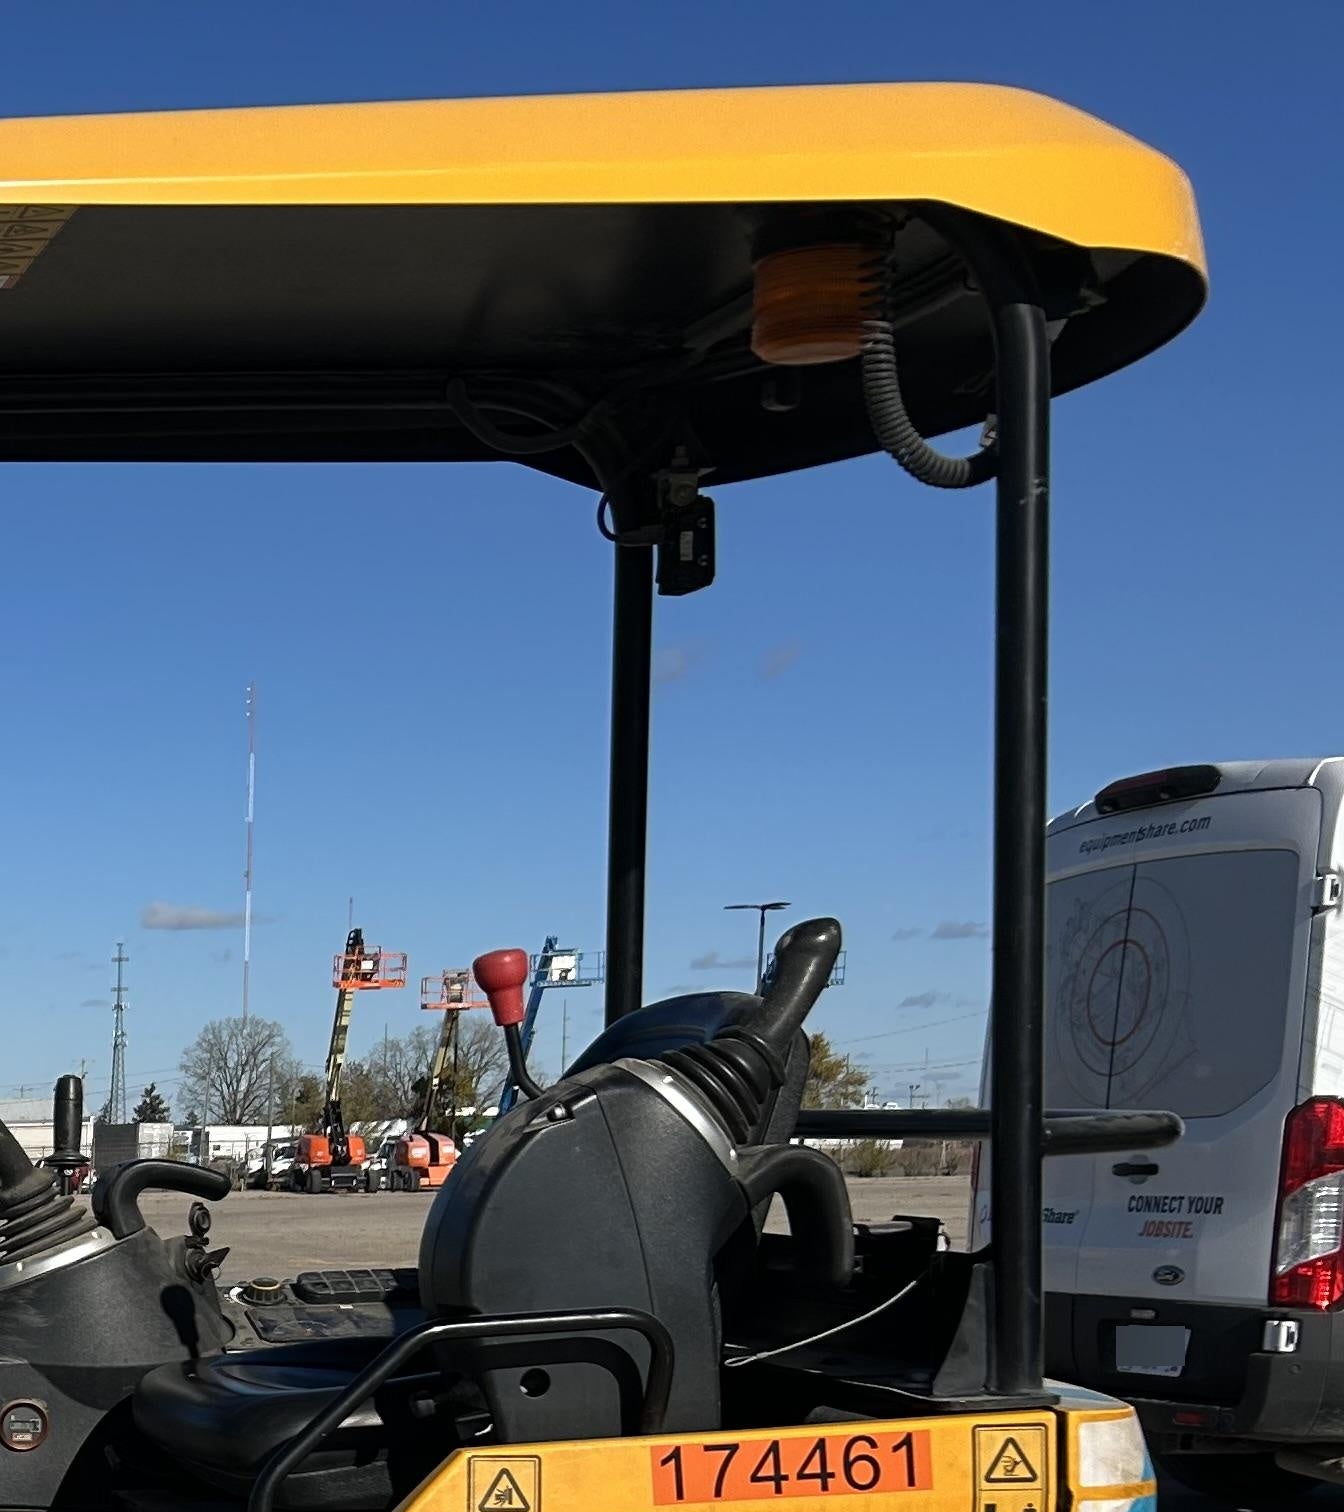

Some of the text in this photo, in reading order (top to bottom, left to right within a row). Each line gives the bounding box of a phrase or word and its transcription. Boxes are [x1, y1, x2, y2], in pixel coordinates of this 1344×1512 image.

[1127, 1194, 1225, 1215] CONNECT YOUR
[659, 1431, 917, 1501] 174461
